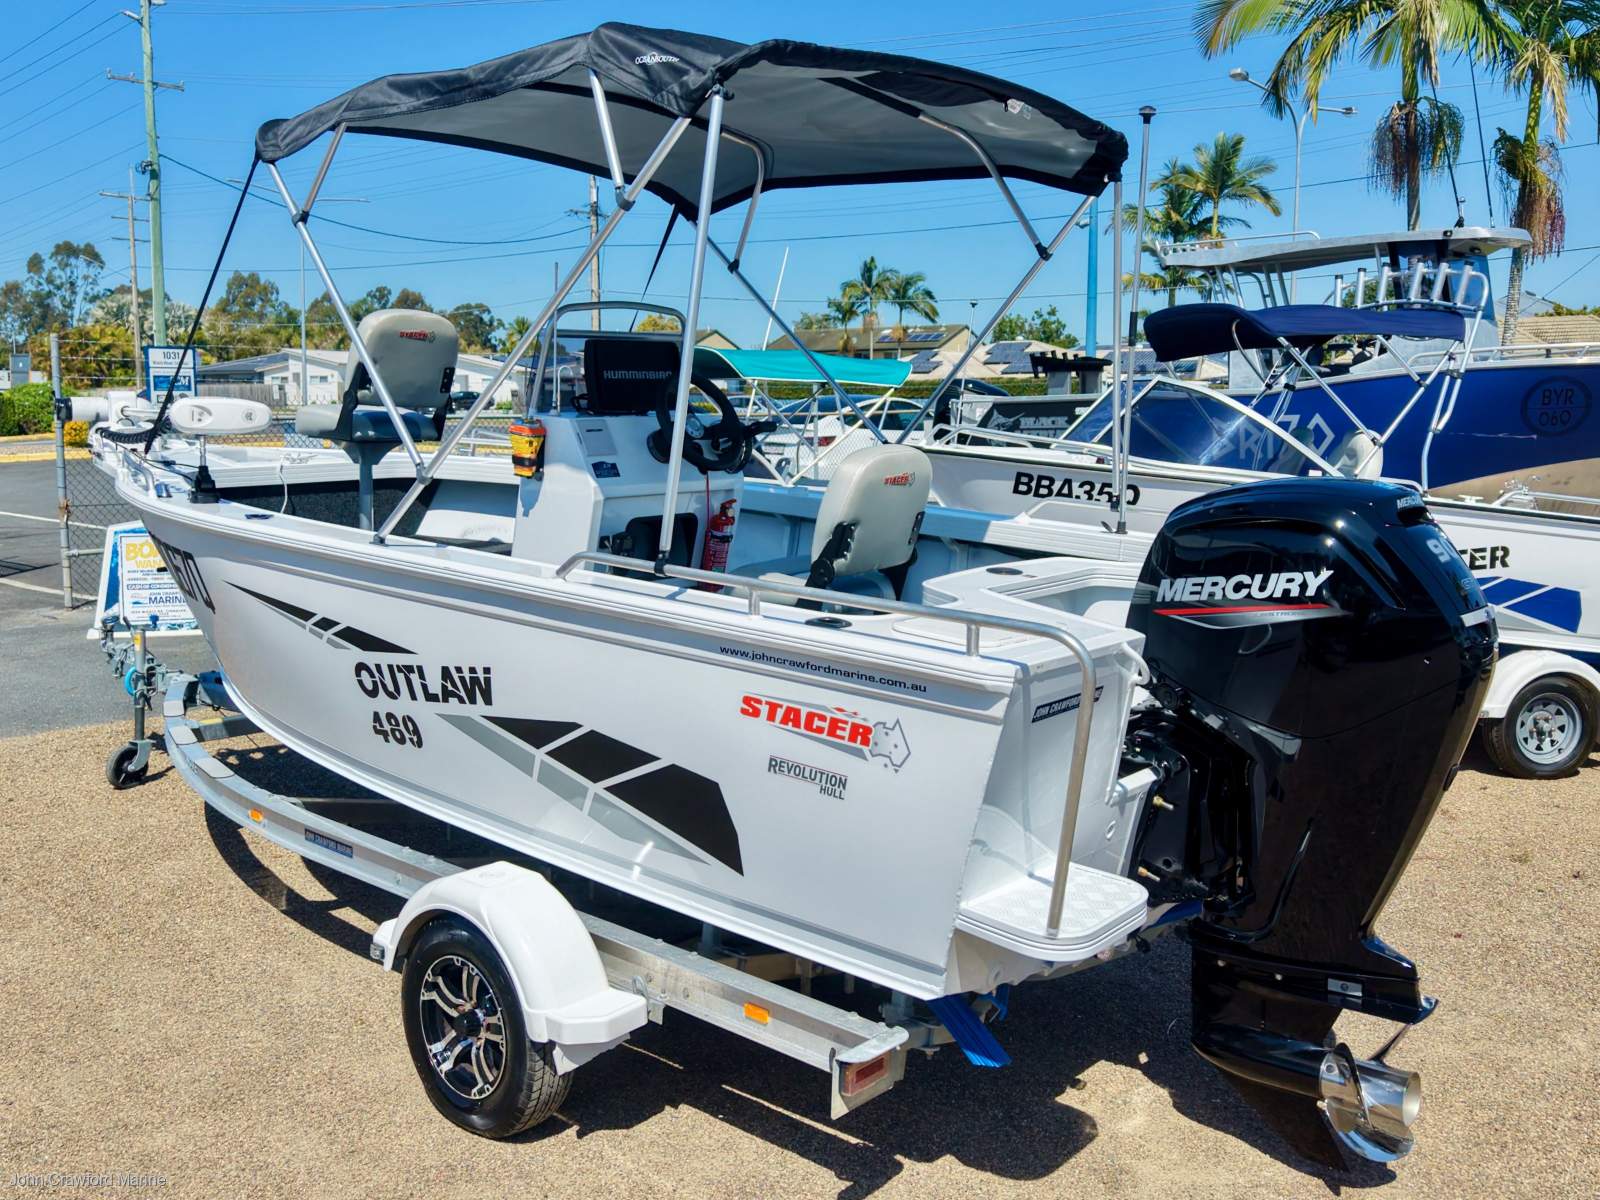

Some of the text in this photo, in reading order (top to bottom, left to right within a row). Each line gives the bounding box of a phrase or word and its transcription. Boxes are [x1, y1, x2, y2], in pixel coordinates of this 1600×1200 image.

[163, 351, 180, 360] 1031
[1541, 388, 1575, 406] BYR
[135, 560, 166, 569] WAN
[1156, 568, 1335, 603] MERCURY
[354, 661, 493, 706] OUTLAW
[719, 645, 928, 694] www.johncrawfordmarine.com.au
[372, 710, 424, 749] 489
[739, 695, 874, 748] STACER
[767, 756, 848, 791] REVOLUTION
[818, 783, 845, 801] HULL
